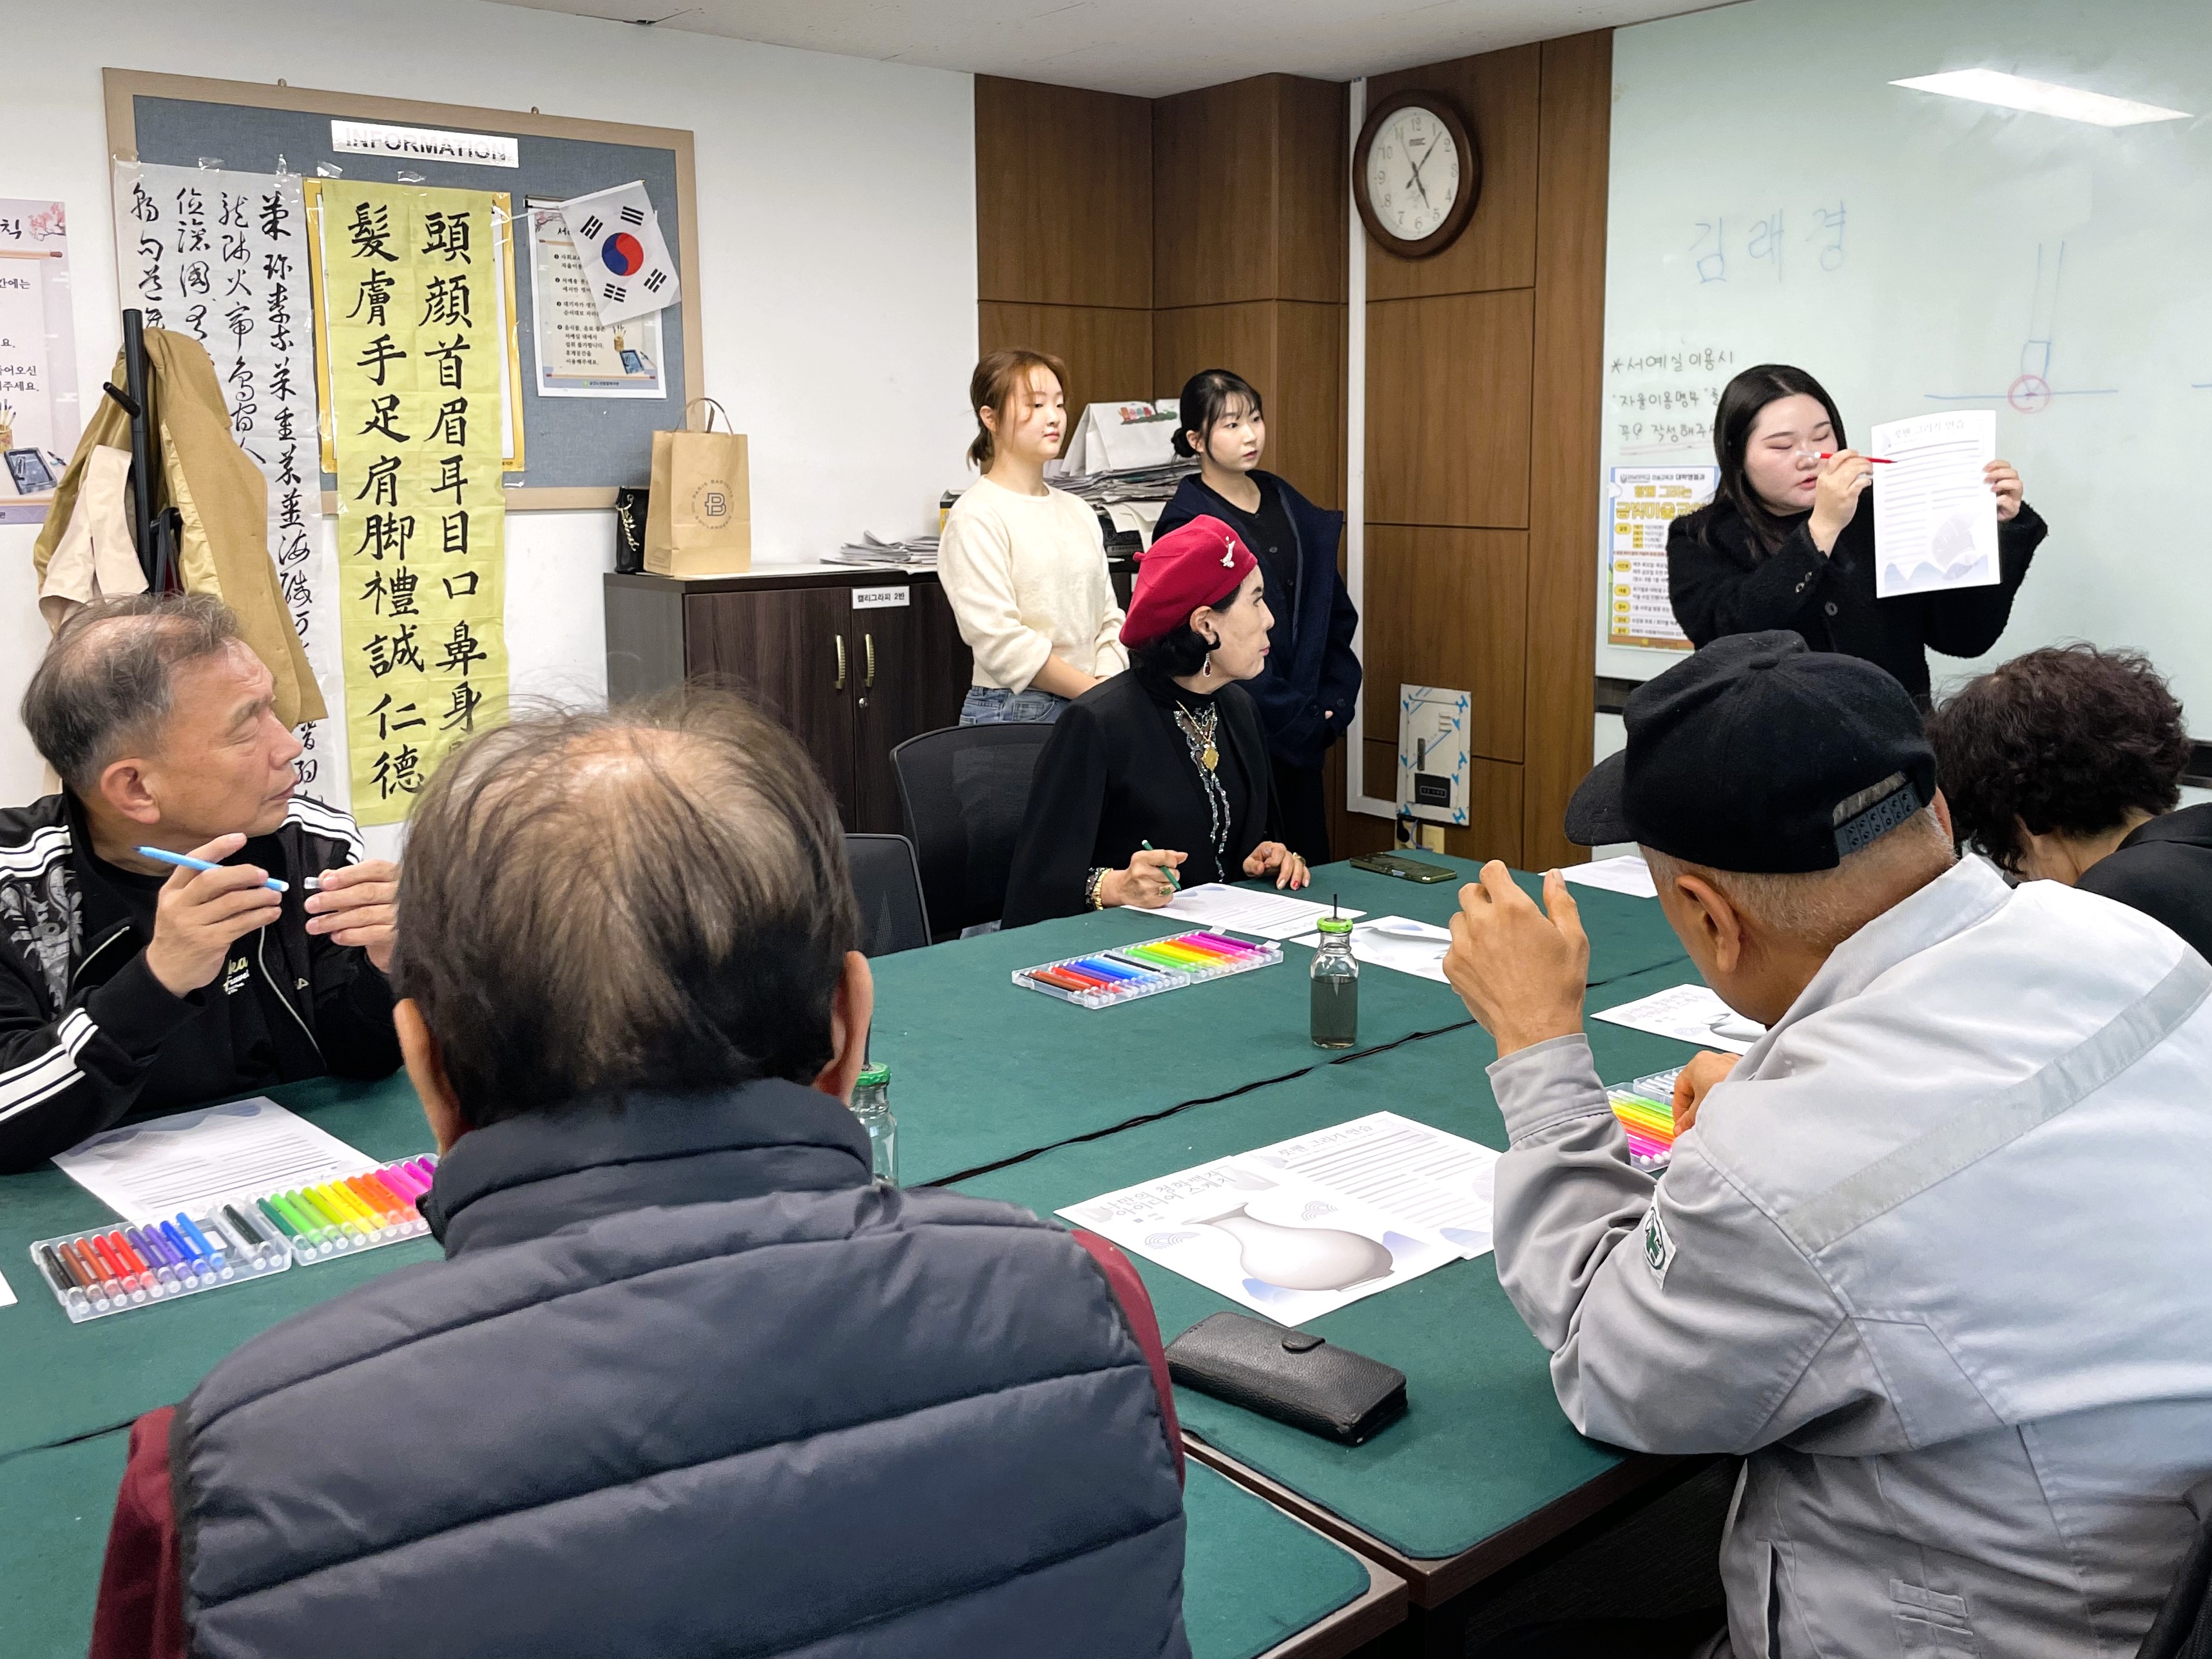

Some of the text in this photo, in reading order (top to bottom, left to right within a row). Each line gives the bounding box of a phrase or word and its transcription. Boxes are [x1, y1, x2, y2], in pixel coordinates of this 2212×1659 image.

[1411, 117, 1422, 131] 12
[345, 128, 506, 160] INFORMATION
[1444, 138, 1451, 153] 2
[1378, 146, 1393, 160] 10
[1378, 170, 1386, 185] 9
[1385, 194, 1392, 208] 8
[1398, 211, 1405, 225] 7
[1432, 209, 1441, 221] 5
[0, 218, 22, 240] 칙
[1414, 216, 1423, 229] 6
[557, 227, 570, 236] 서
[0, 365, 36, 376] 어오신
[0, 381, 39, 392] 주세요.
[419, 211, 487, 753] 頭顔首眉耳目口鼻身
[858, 592, 905, 603] 캘리그라피 2반
[1308, 1133, 1348, 1148] 그리기
[1345, 1126, 1373, 1135] 연습
[1099, 1191, 1156, 1211] 나만의
